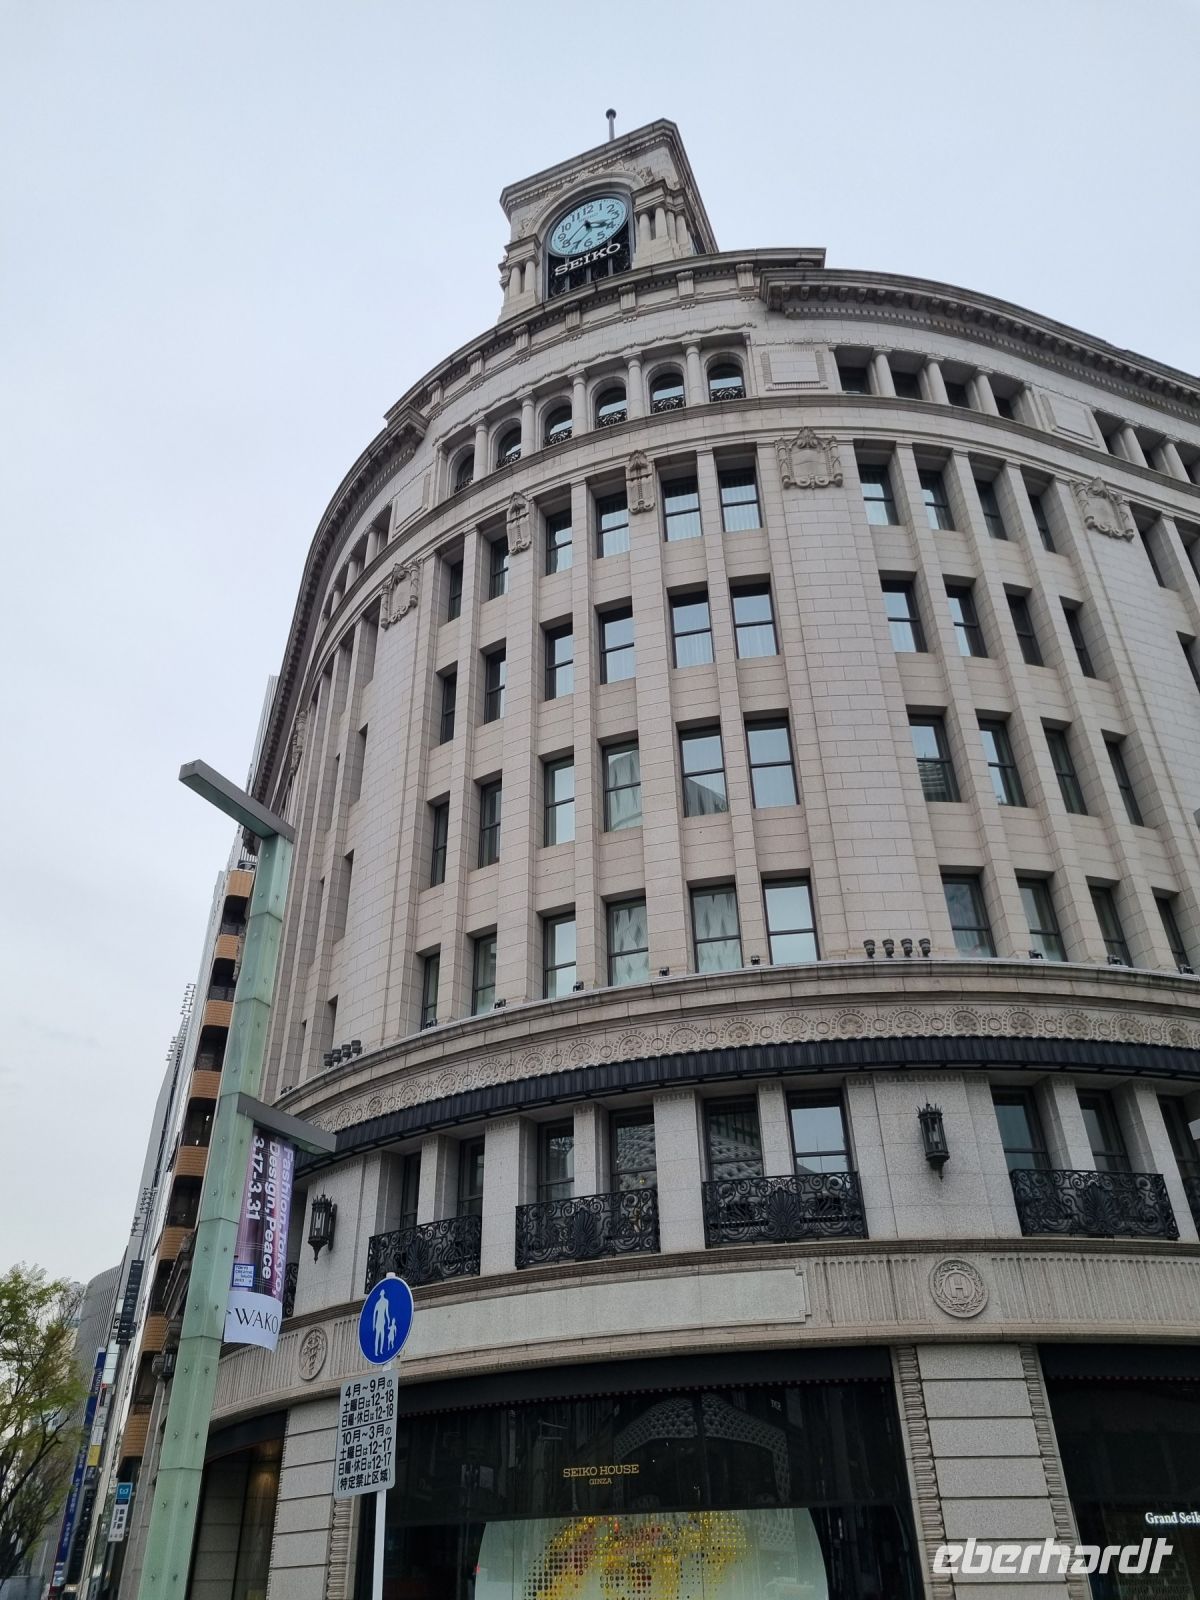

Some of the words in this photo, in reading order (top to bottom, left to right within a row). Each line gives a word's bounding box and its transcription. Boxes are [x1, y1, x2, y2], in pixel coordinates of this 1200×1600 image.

[583, 204, 594, 216] 12
[606, 204, 615, 213] 2
[571, 212, 580, 222] 11
[611, 210, 620, 220] 3
[561, 222, 572, 233] 10
[606, 220, 616, 230] 4
[557, 233, 567, 242] 9
[597, 231, 606, 240] 5
[562, 239, 571, 249] 8
[573, 239, 582, 250] 7
[584, 238, 593, 247] 6
[554, 243, 621, 276] SEIKO
[246, 1135, 265, 1220] 3.17-3.31
[263, 1140, 281, 1213] Design,
[262, 1215, 276, 1279] Peace
[234, 1307, 278, 1334] WAKO
[563, 1467, 598, 1478] SEIKO
[600, 1464, 640, 1475] HOUSE
[1145, 1511, 1178, 1524] Grand
